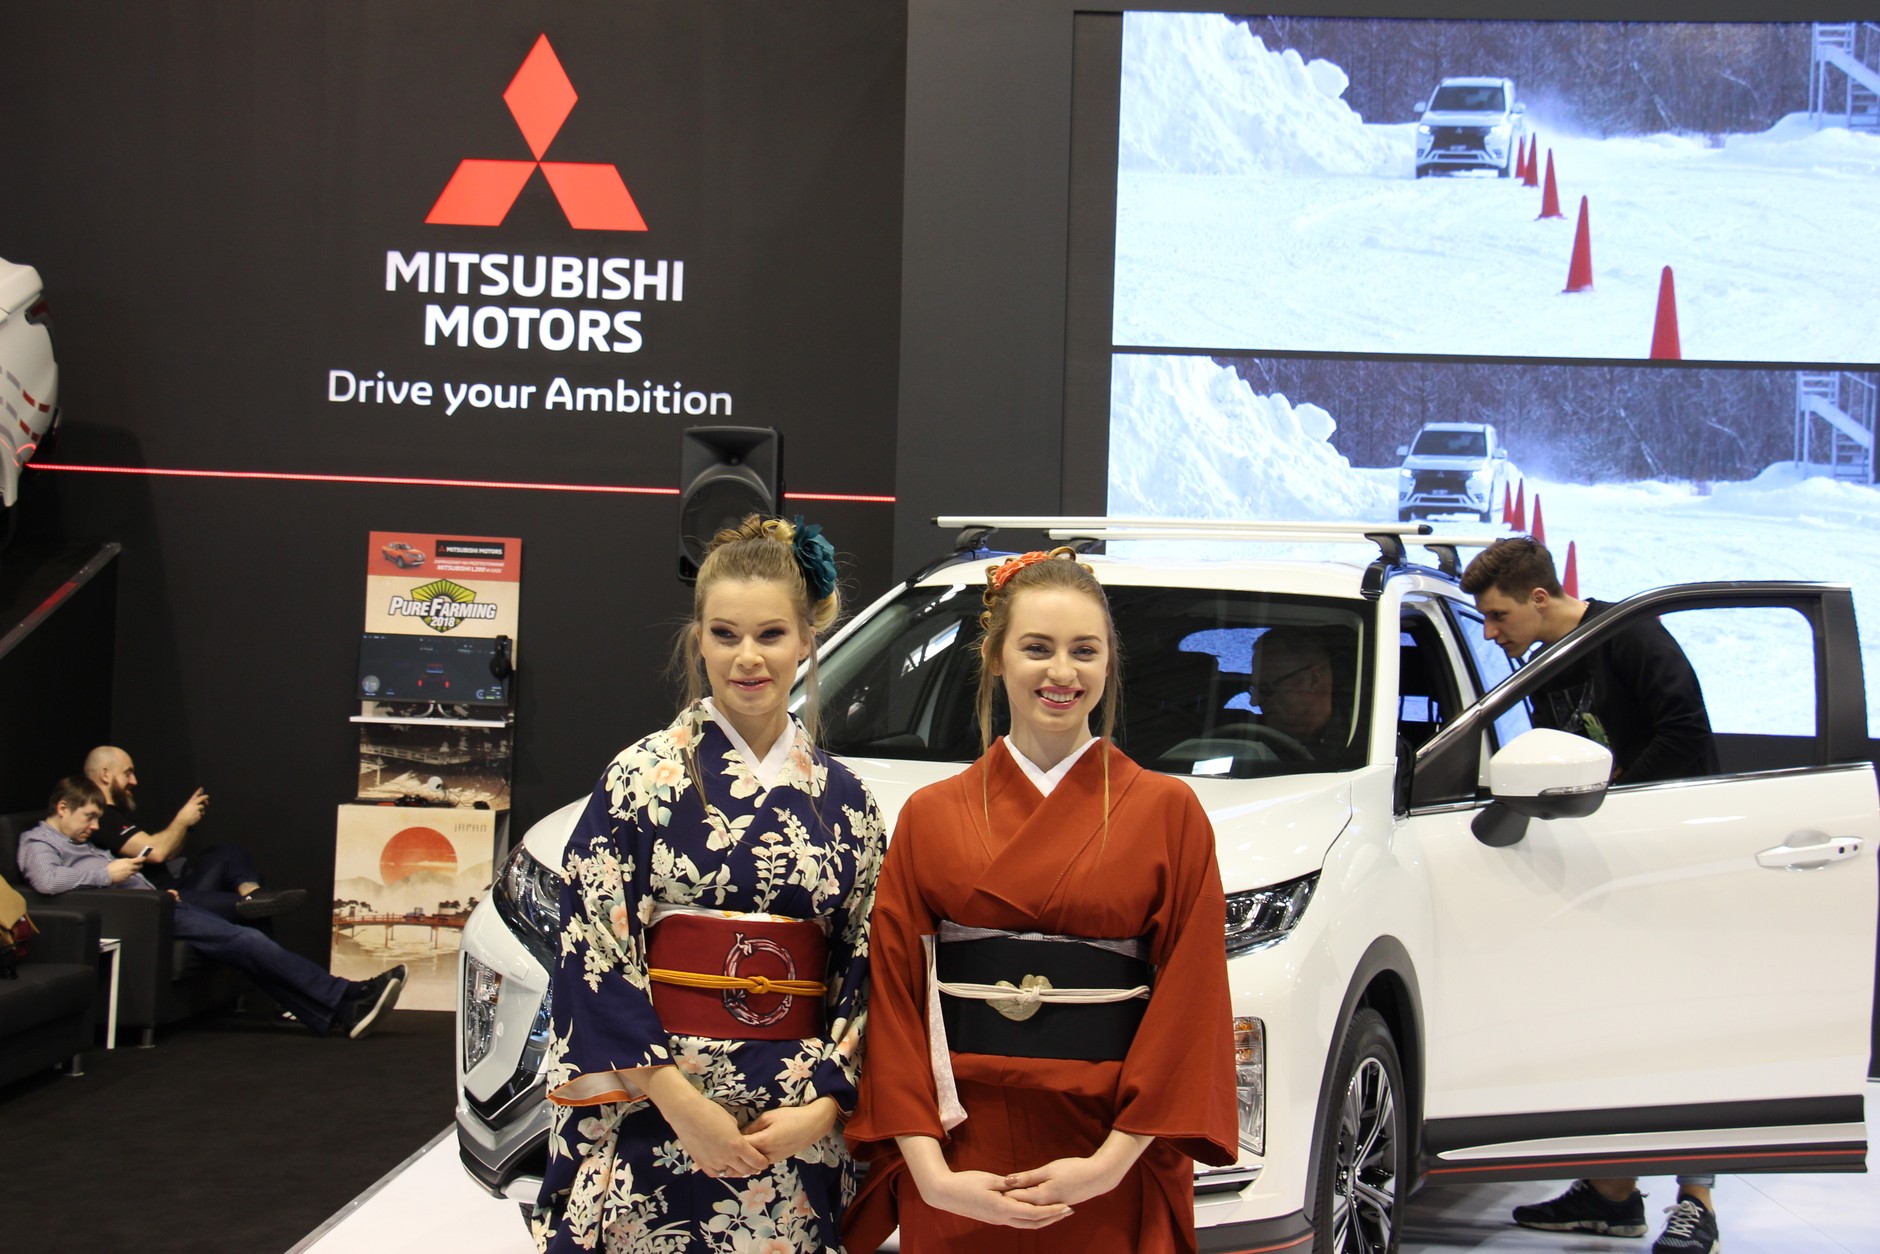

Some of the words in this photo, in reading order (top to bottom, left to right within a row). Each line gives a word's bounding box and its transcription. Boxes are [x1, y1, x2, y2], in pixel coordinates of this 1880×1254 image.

[385, 250, 684, 302] MITSUBISHI
[424, 304, 643, 354] MOTORS
[328, 369, 433, 406] Drive
[443, 382, 537, 417] your
[545, 377, 732, 416] Ambition
[446, 546, 479, 554] MITSUBISHI
[430, 616, 456, 627] 2018
[454, 823, 487, 833] JAPAN
